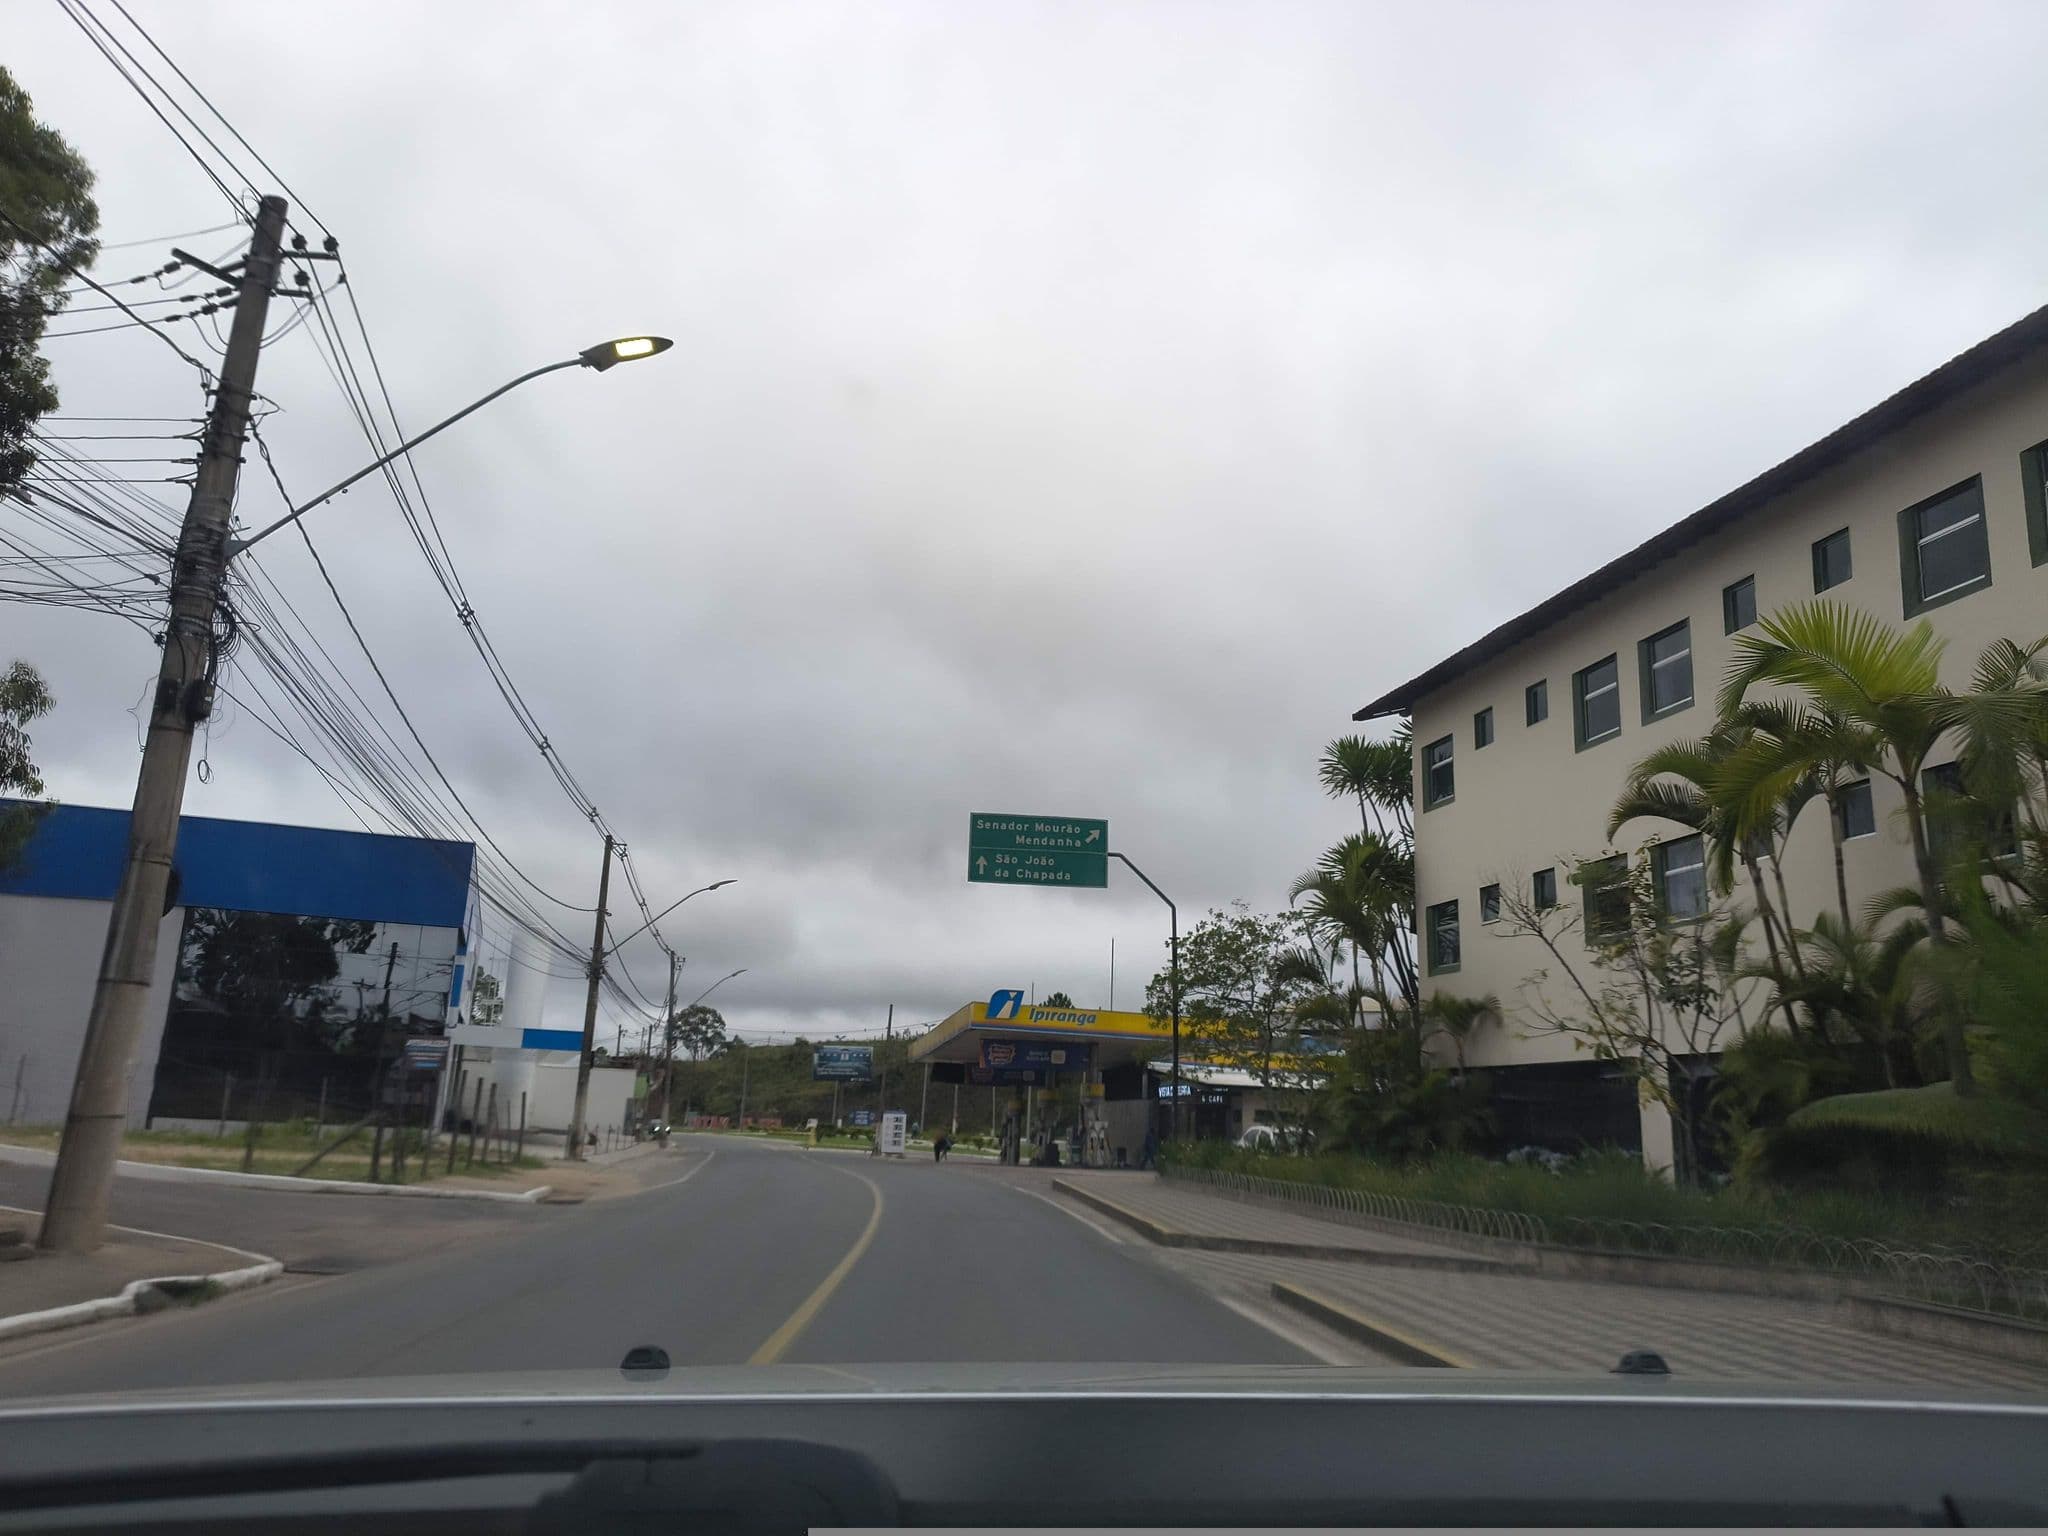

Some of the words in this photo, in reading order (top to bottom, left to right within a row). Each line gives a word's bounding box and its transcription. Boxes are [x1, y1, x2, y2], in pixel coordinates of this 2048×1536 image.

[976, 819, 1029, 832] Senador
[1035, 823, 1081, 834] Mourão
[1015, 835, 1081, 848] Mendanha
[995, 854, 1018, 864] São
[1025, 856, 1055, 866] João
[994, 868, 1009, 878] da
[1016, 868, 1071, 881] Chapada
[1029, 1008, 1097, 1026] Ipiranga
